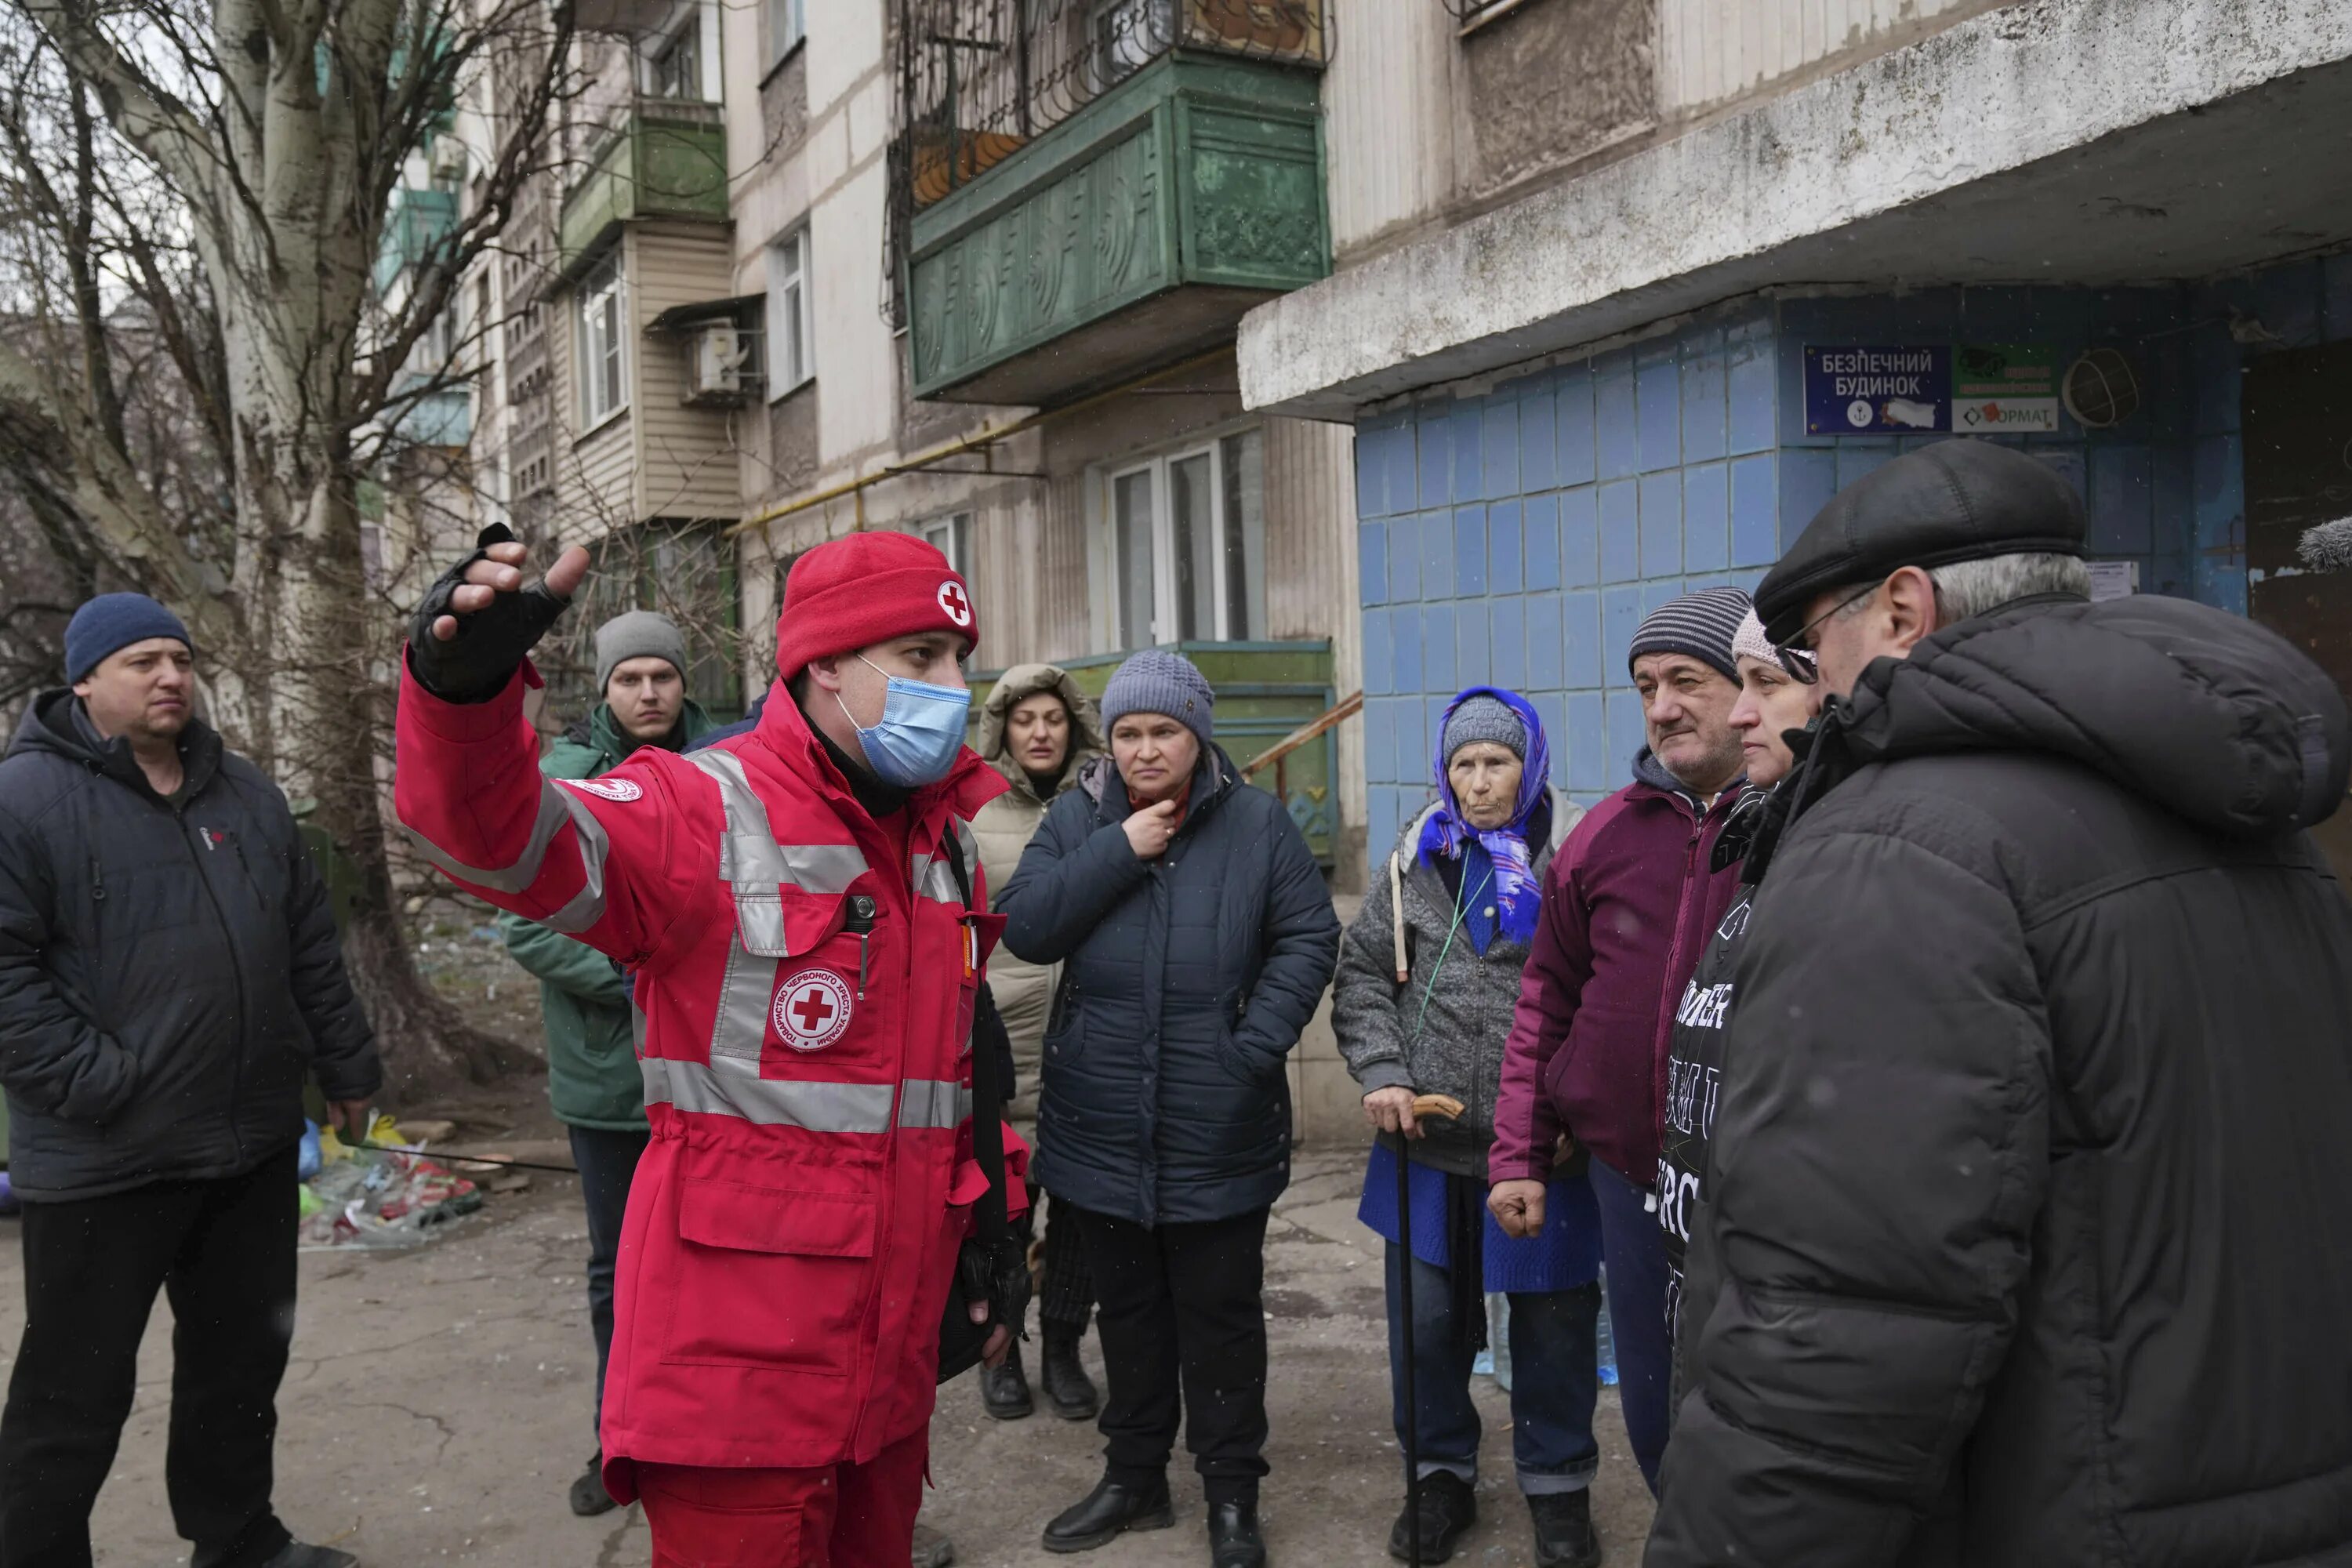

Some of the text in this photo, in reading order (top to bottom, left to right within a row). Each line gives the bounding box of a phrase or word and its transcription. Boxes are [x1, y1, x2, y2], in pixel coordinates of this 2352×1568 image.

[1822, 349, 1933, 373] БЕЗПЕЧНИЙ
[1835, 376, 1921, 398] БУДИНОК
[1994, 409, 2049, 423] ОРМАТ
[775, 972, 850, 1046] ТОВАРИСТВО ЧЕРВОНОГО ХРЕСТА УКРАЇНИ
